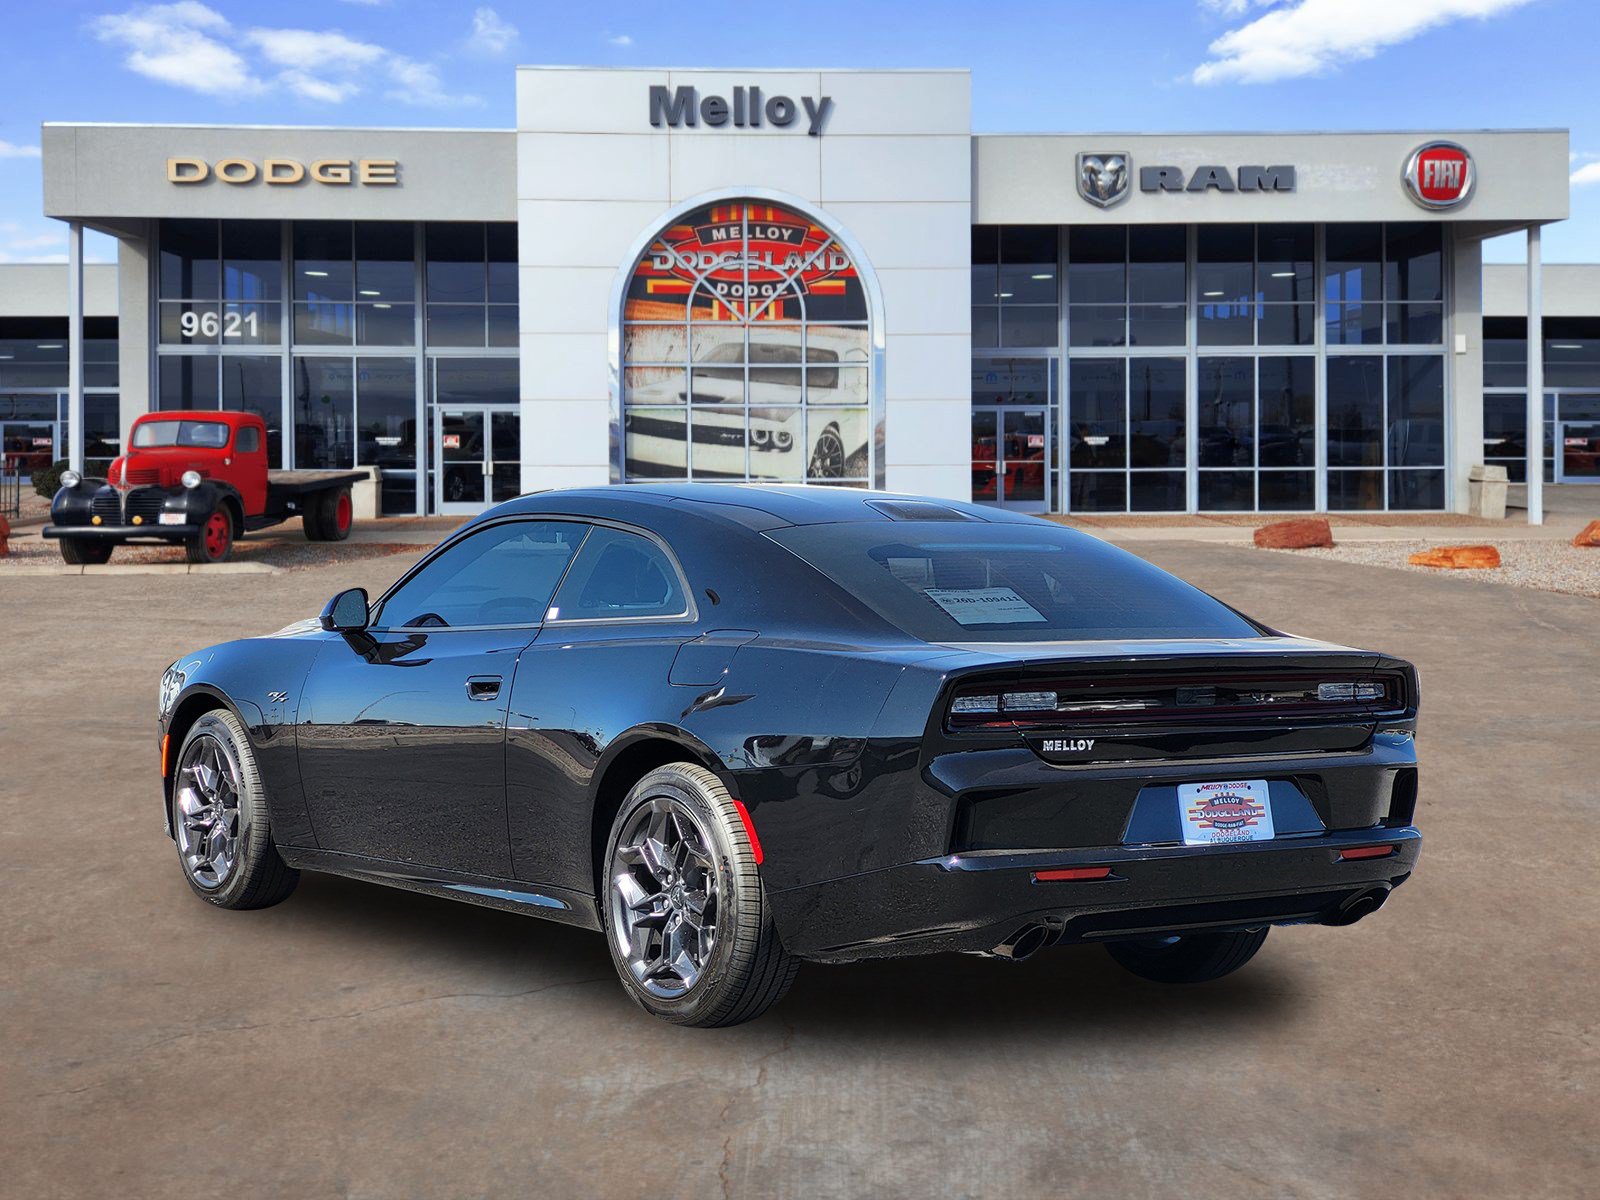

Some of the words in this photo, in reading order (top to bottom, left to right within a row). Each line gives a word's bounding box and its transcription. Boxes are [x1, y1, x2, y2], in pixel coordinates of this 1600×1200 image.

[649, 86, 832, 136] Melloy
[167, 158, 398, 185] DODGE
[1140, 165, 1296, 192] RAM
[1424, 160, 1463, 189] FIAT
[181, 311, 257, 337] 9621
[1043, 740, 1095, 751] MELLOY
[1212, 830, 1250, 838] DODGELAND
